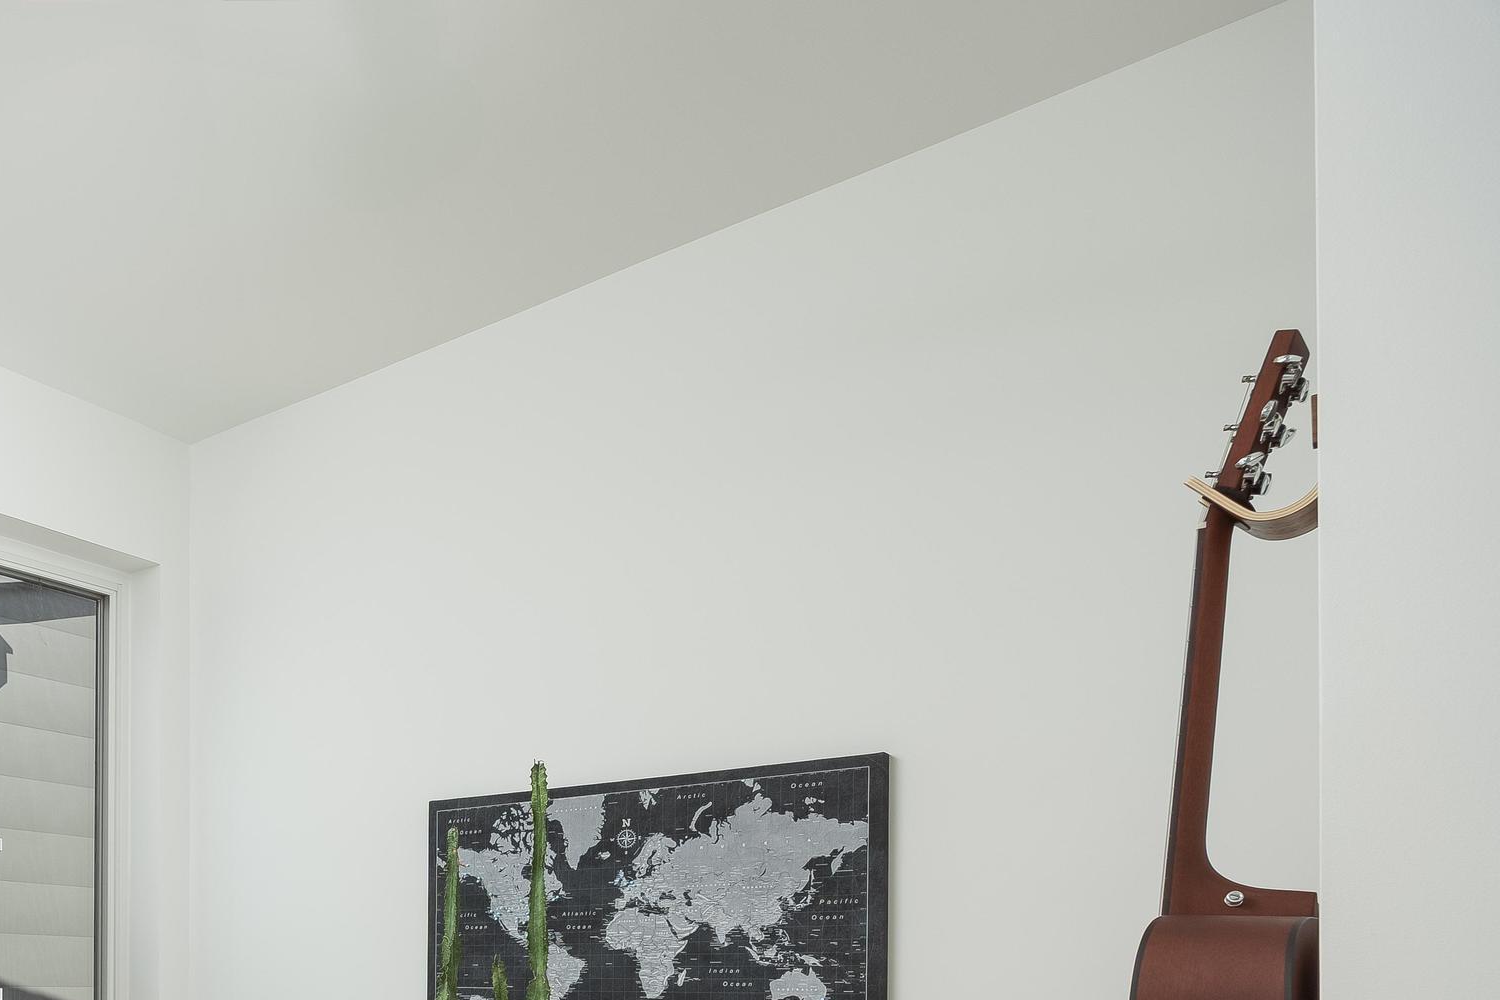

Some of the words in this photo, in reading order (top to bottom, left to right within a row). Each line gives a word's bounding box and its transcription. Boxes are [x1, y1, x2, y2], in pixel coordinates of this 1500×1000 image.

[790, 780, 824, 789] Ocean
[676, 792, 706, 800] Arctic
[621, 818, 632, 827] N
